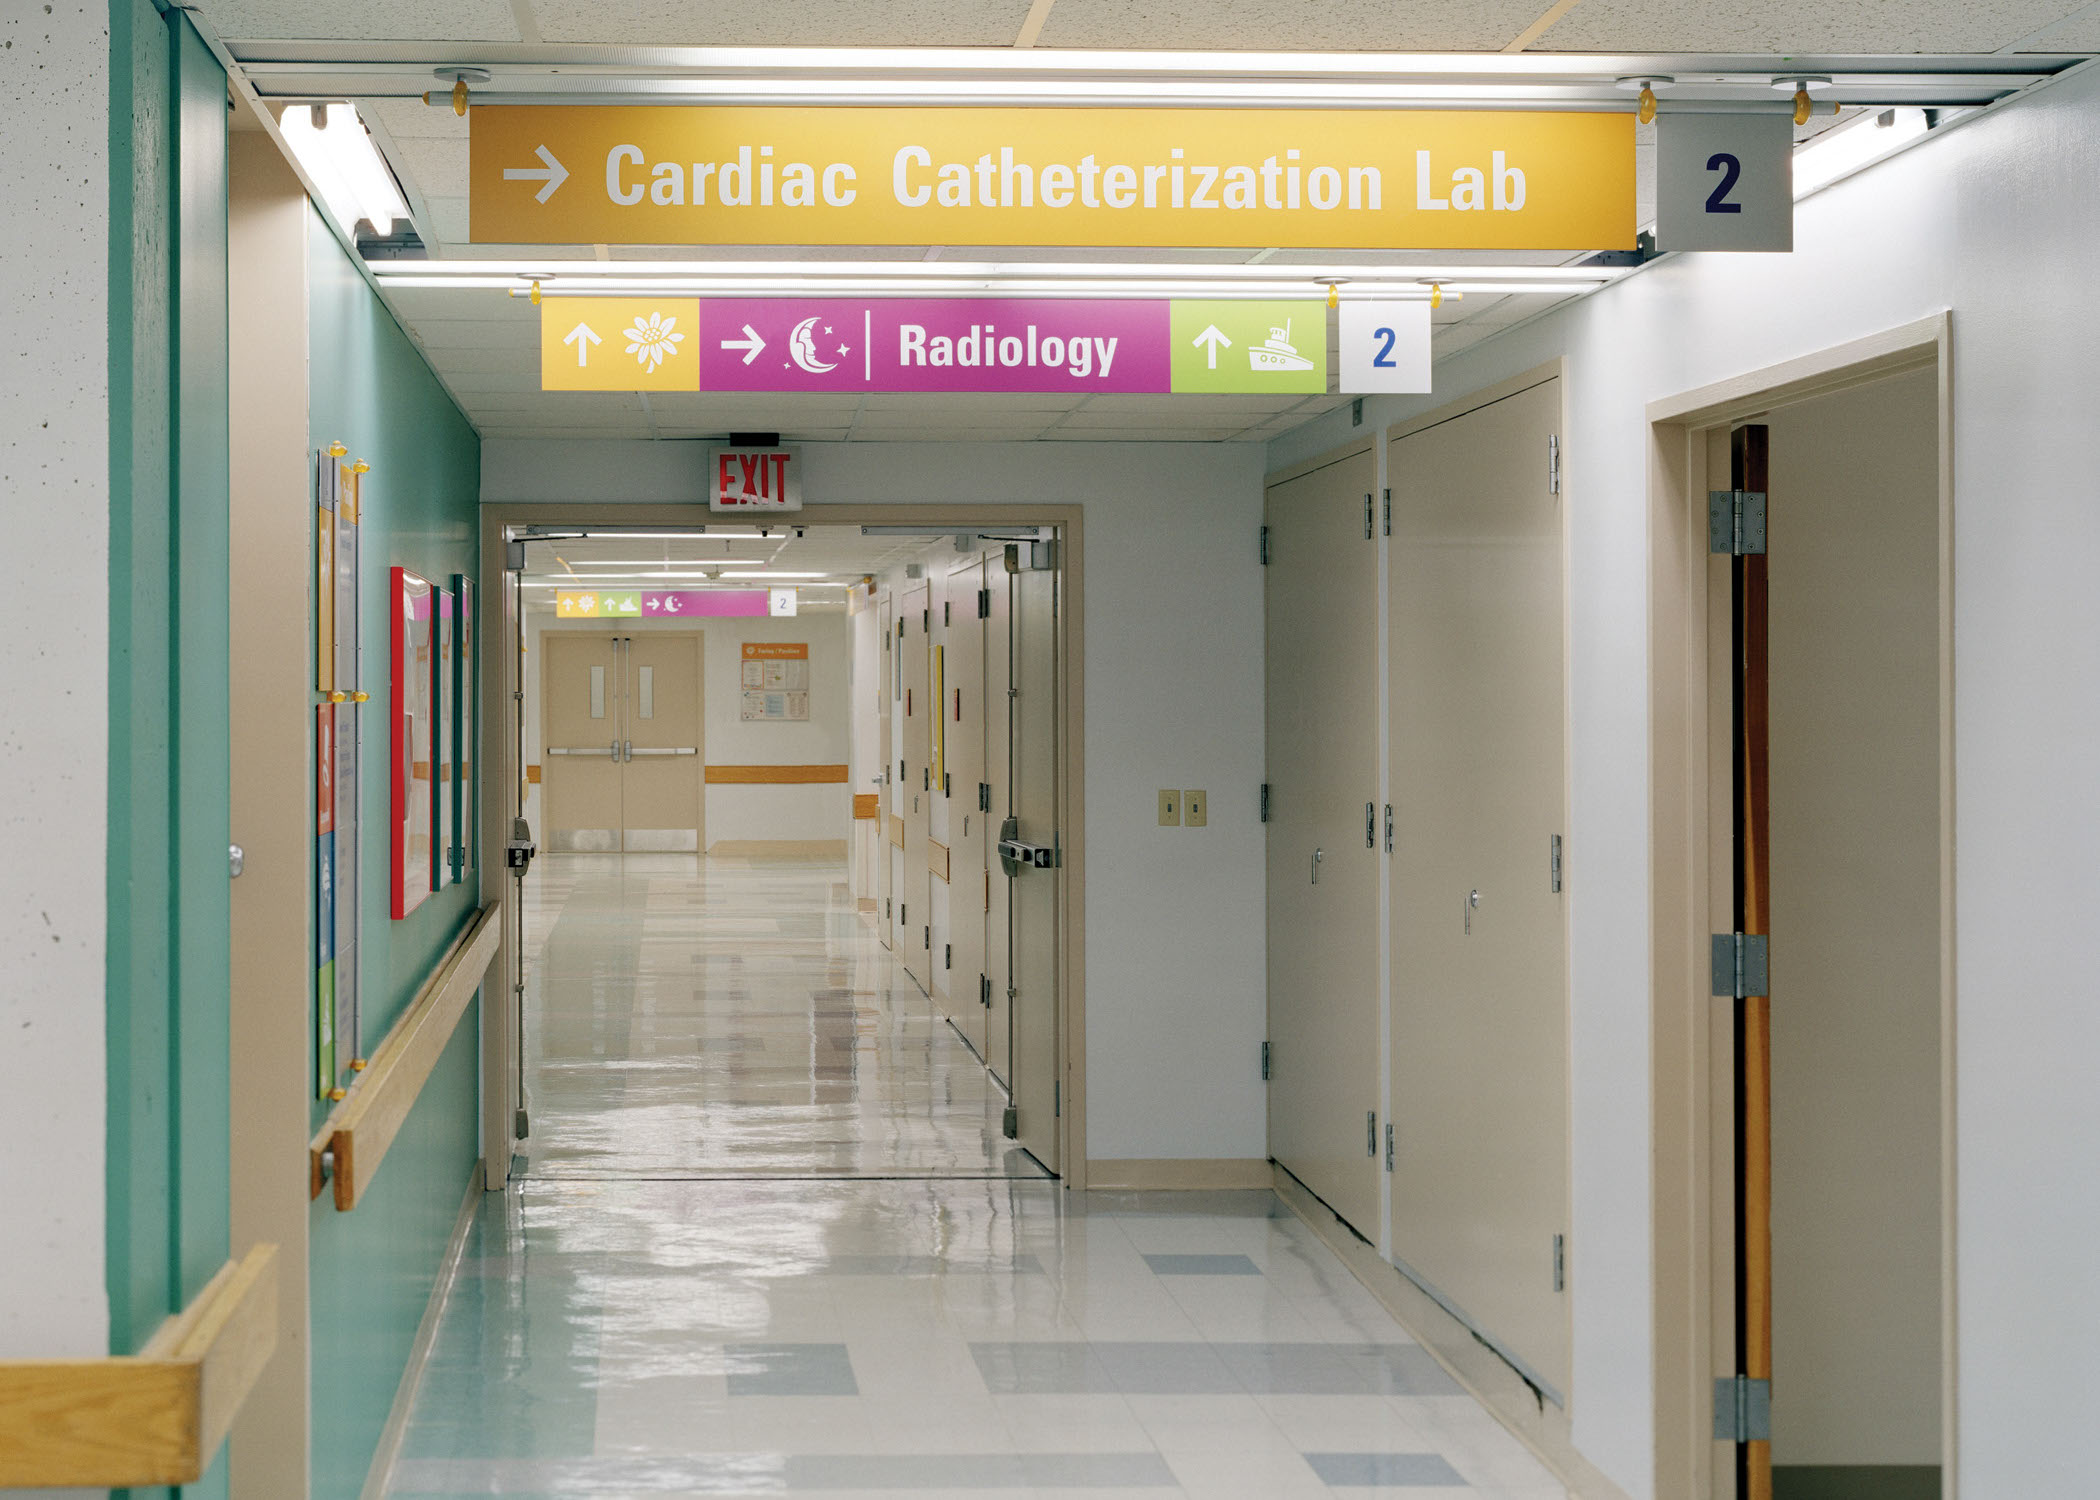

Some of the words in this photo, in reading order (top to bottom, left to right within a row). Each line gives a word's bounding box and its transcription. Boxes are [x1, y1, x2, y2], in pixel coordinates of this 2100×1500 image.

[607, 145, 856, 207] Cardiac
[893, 146, 1382, 210] Catheterization
[1416, 150, 1526, 211] Lab
[1706, 153, 1741, 213] 2
[899, 325, 1118, 377] Radiology
[1374, 328, 1396, 367] 2
[720, 454, 790, 504] EXIT
[779, 598, 787, 609] 2
